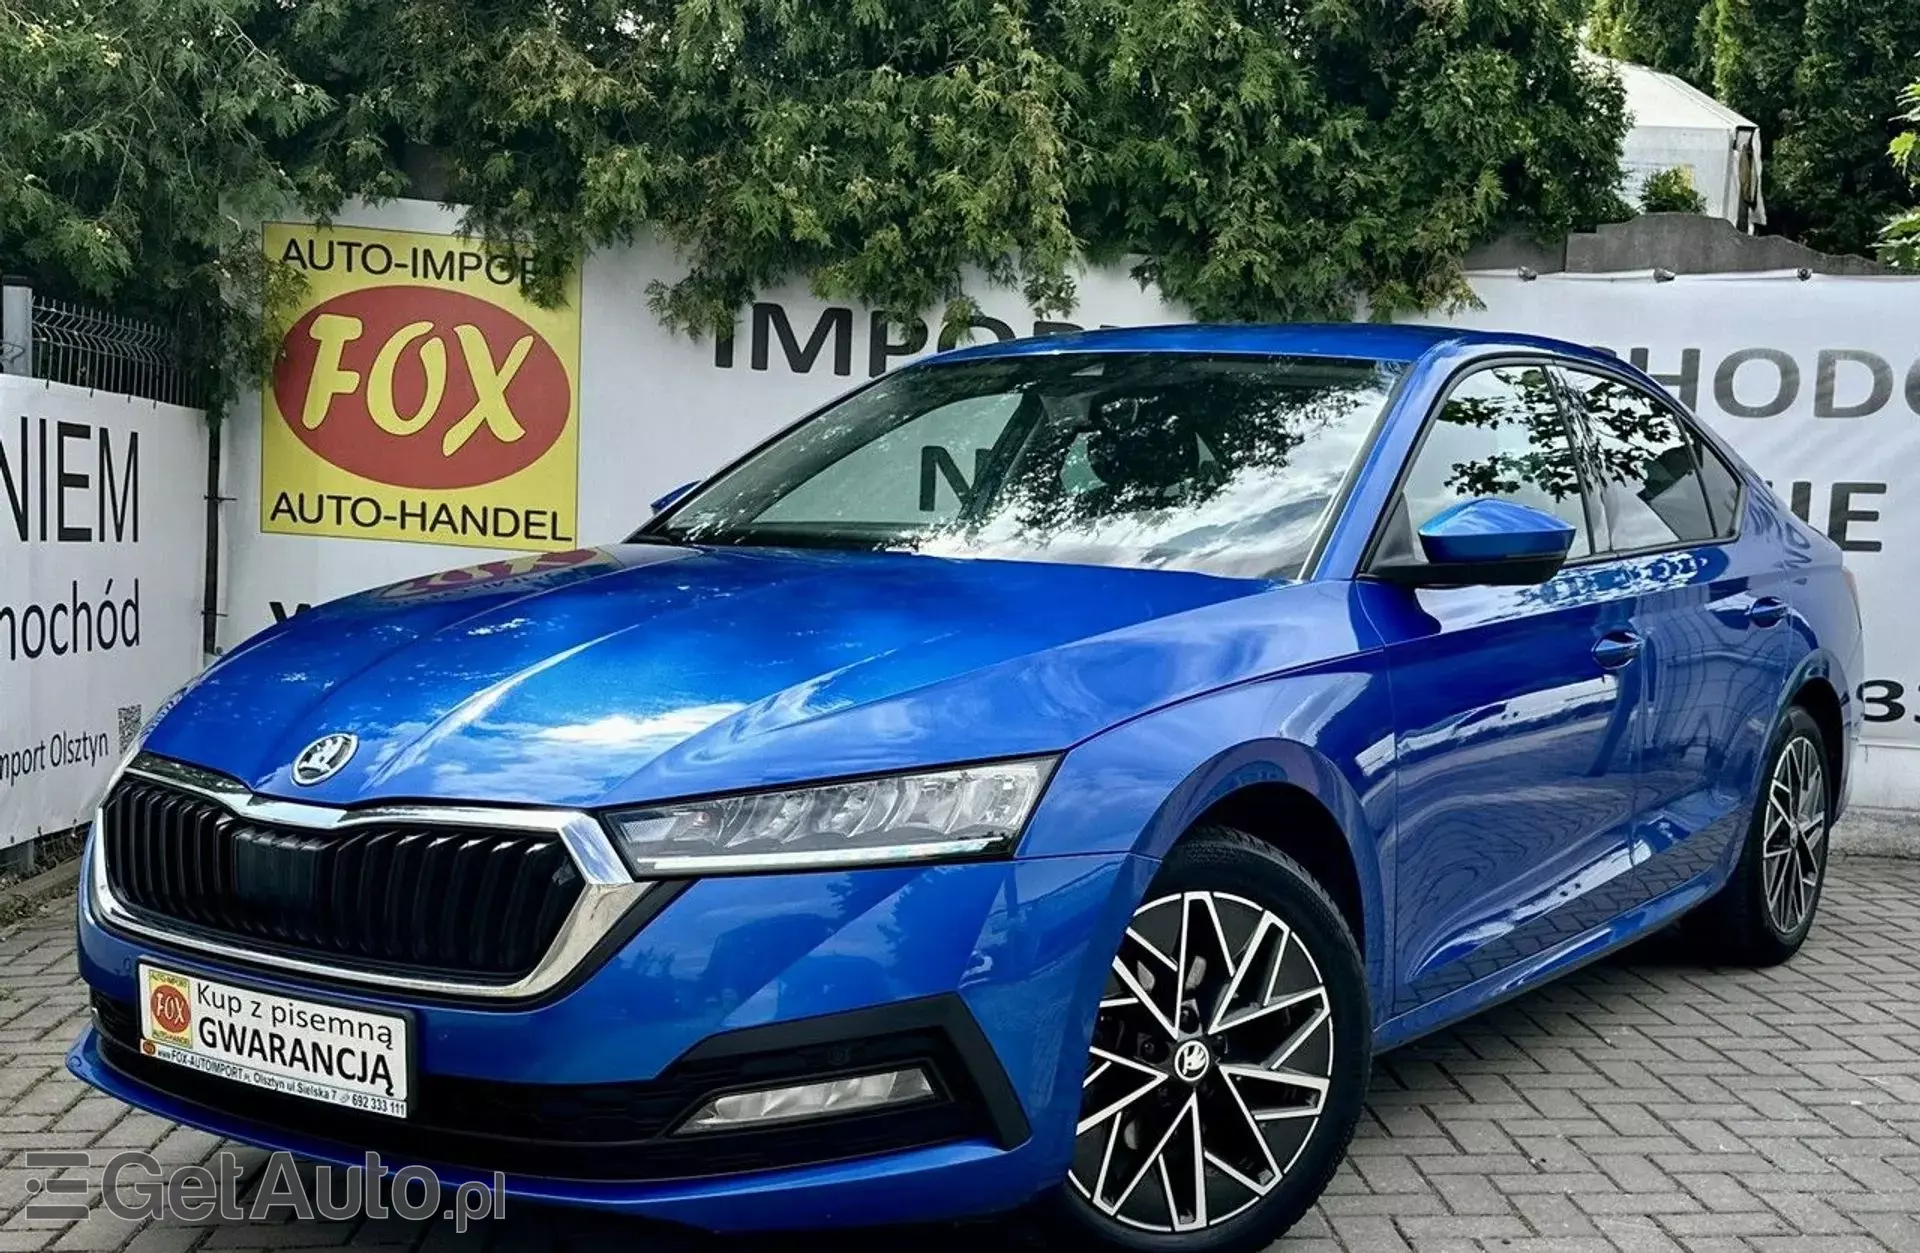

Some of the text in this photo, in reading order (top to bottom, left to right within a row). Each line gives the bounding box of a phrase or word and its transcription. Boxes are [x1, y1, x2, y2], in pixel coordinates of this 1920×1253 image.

[302, 313, 536, 458] FOX
[1600, 347, 1920, 418] HOD
[270, 491, 573, 543] AUTO-HANDEL
[1765, 481, 1887, 551] IE
[50, 730, 108, 767] Olsztyn
[156, 992, 185, 1025] FOX
[198, 983, 393, 1050] Kup z pisemną
[199, 1016, 395, 1096] GWARANCJĄ
[254, 1072, 285, 1091] Olsztyn
[352, 1093, 369, 1109] 692
[370, 1097, 387, 1113] 333
[390, 1101, 405, 1116] 111
